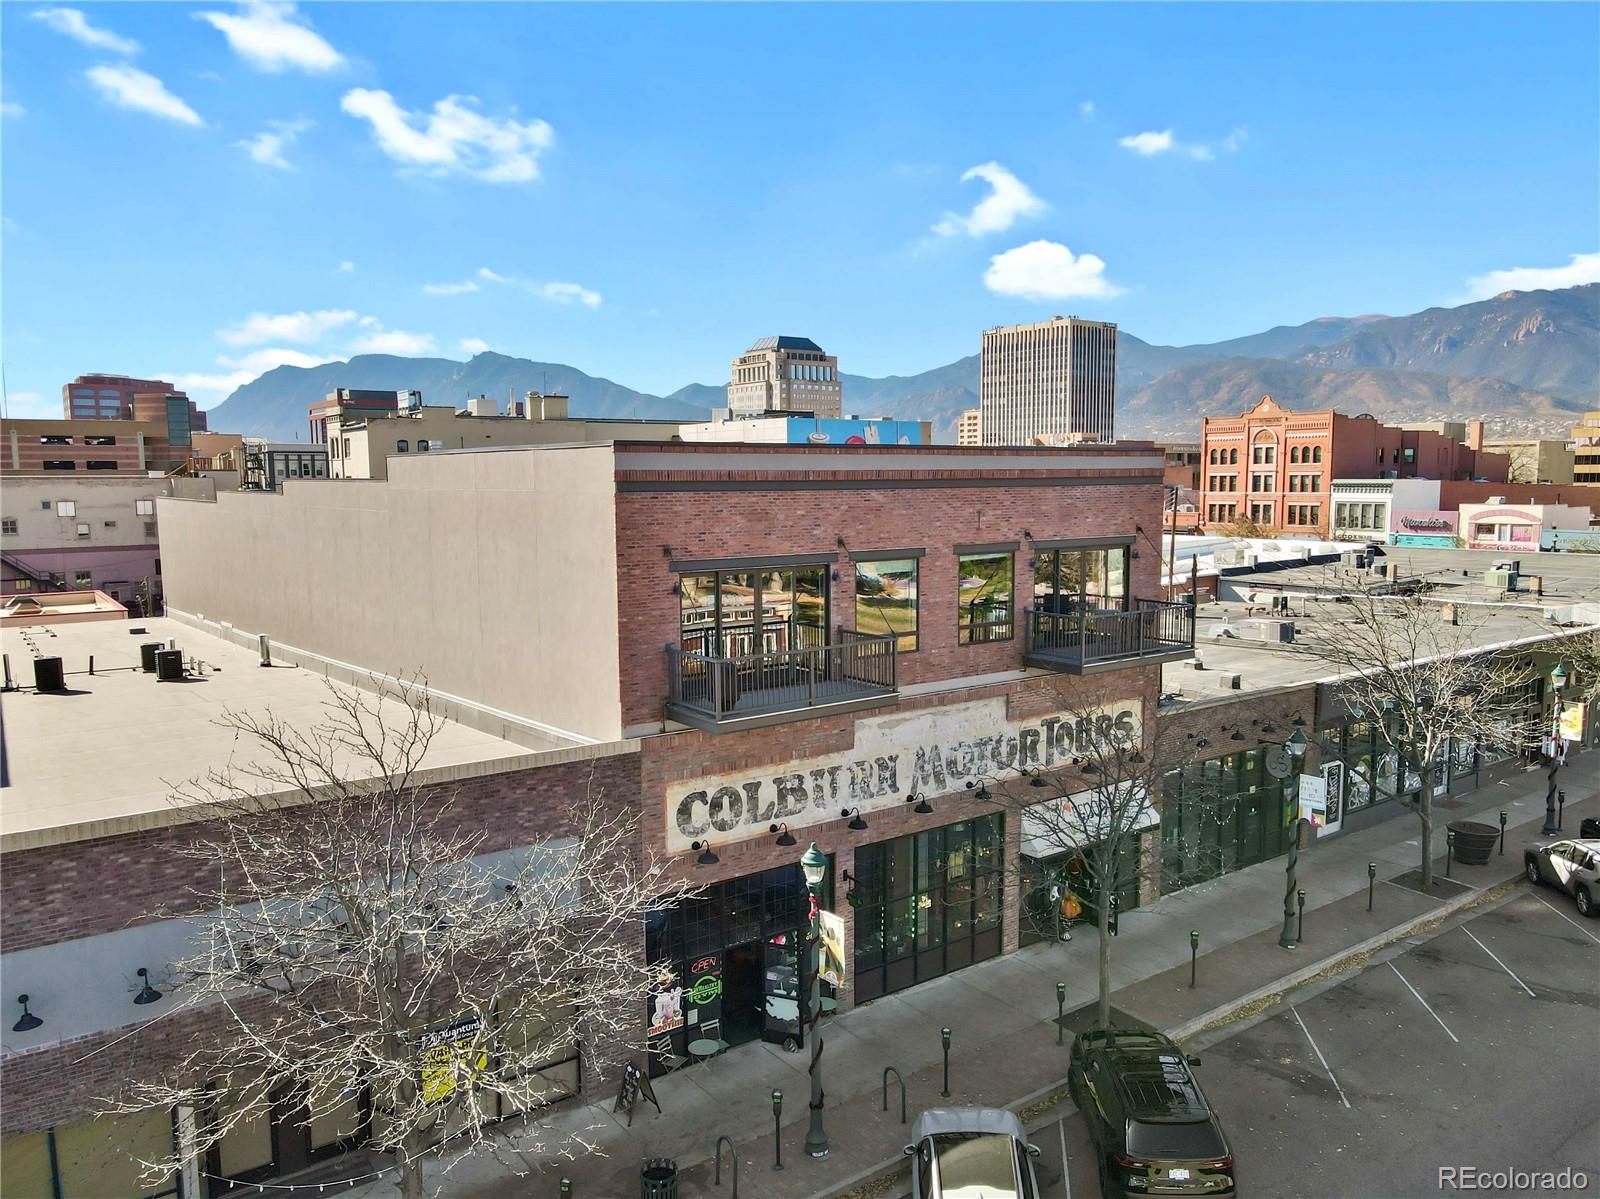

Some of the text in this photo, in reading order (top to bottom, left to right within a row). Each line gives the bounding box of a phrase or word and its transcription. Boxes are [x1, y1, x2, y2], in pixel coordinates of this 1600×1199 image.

[676, 710, 1134, 838] COLBURN MOTOR TOURS
[691, 957, 716, 973] OPEN
